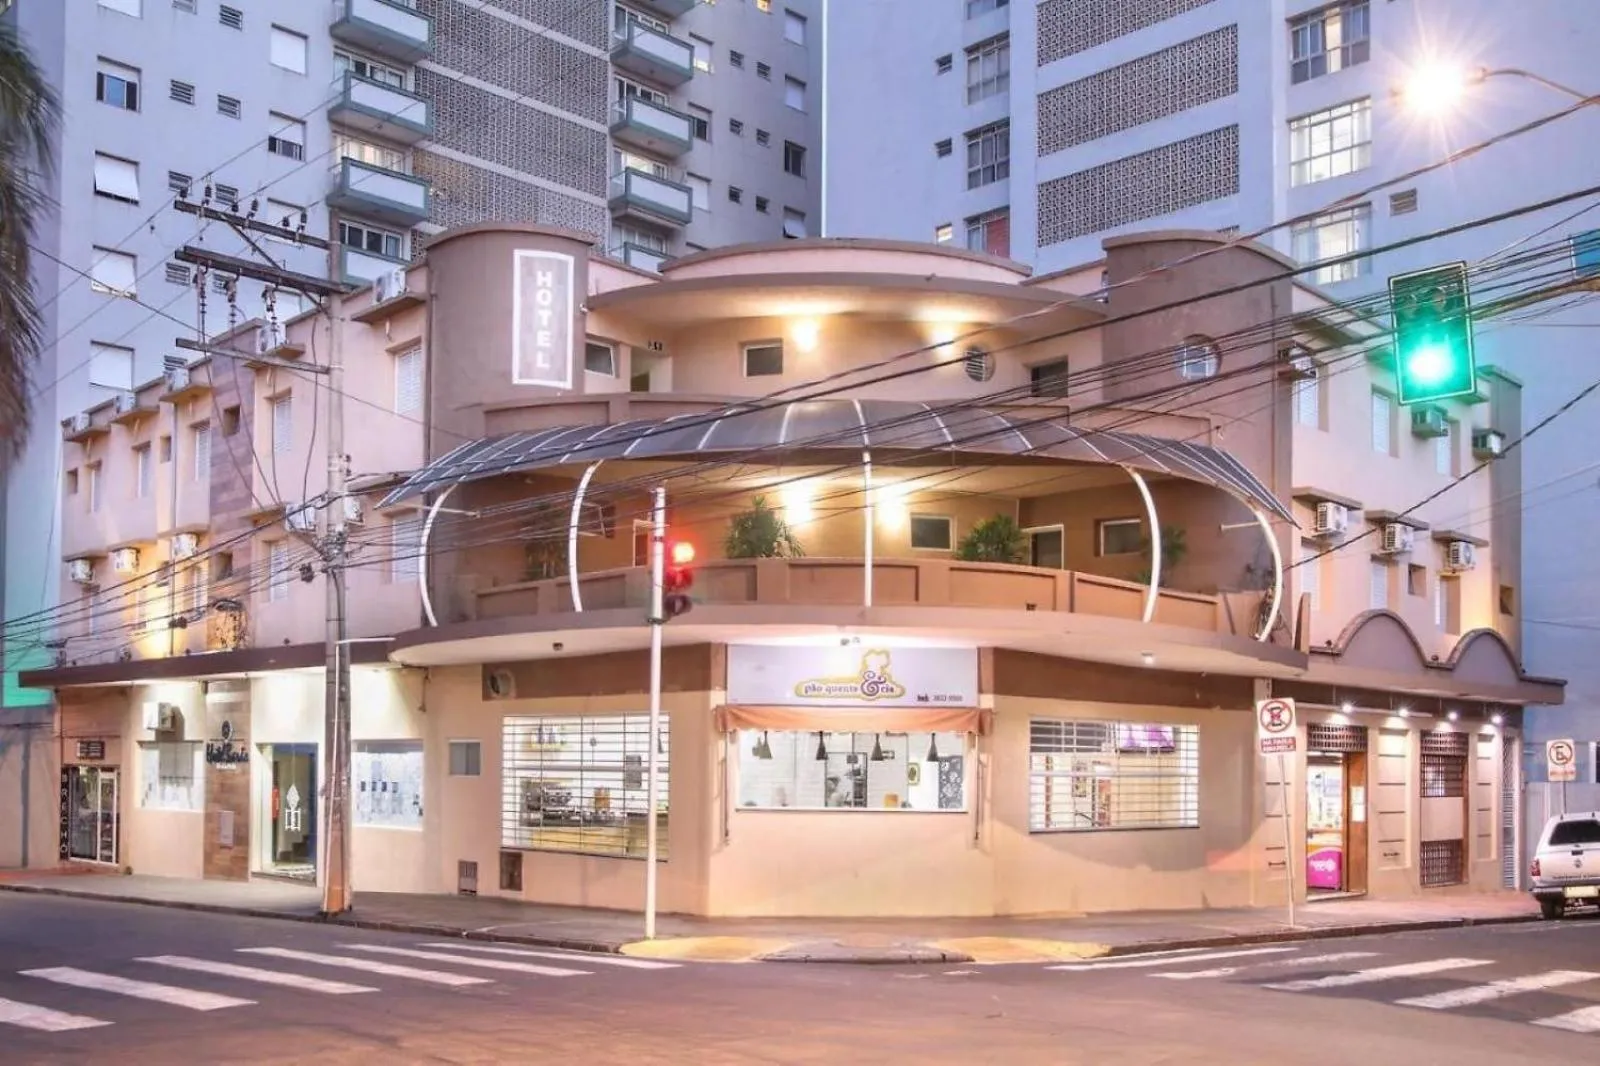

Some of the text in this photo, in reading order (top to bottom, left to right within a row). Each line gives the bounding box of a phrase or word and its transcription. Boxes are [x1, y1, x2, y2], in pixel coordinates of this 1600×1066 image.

[536, 270, 552, 369] HOTEL
[804, 683, 823, 694] pão
[825, 685, 858, 694] quente
[880, 684, 894, 693] cia
